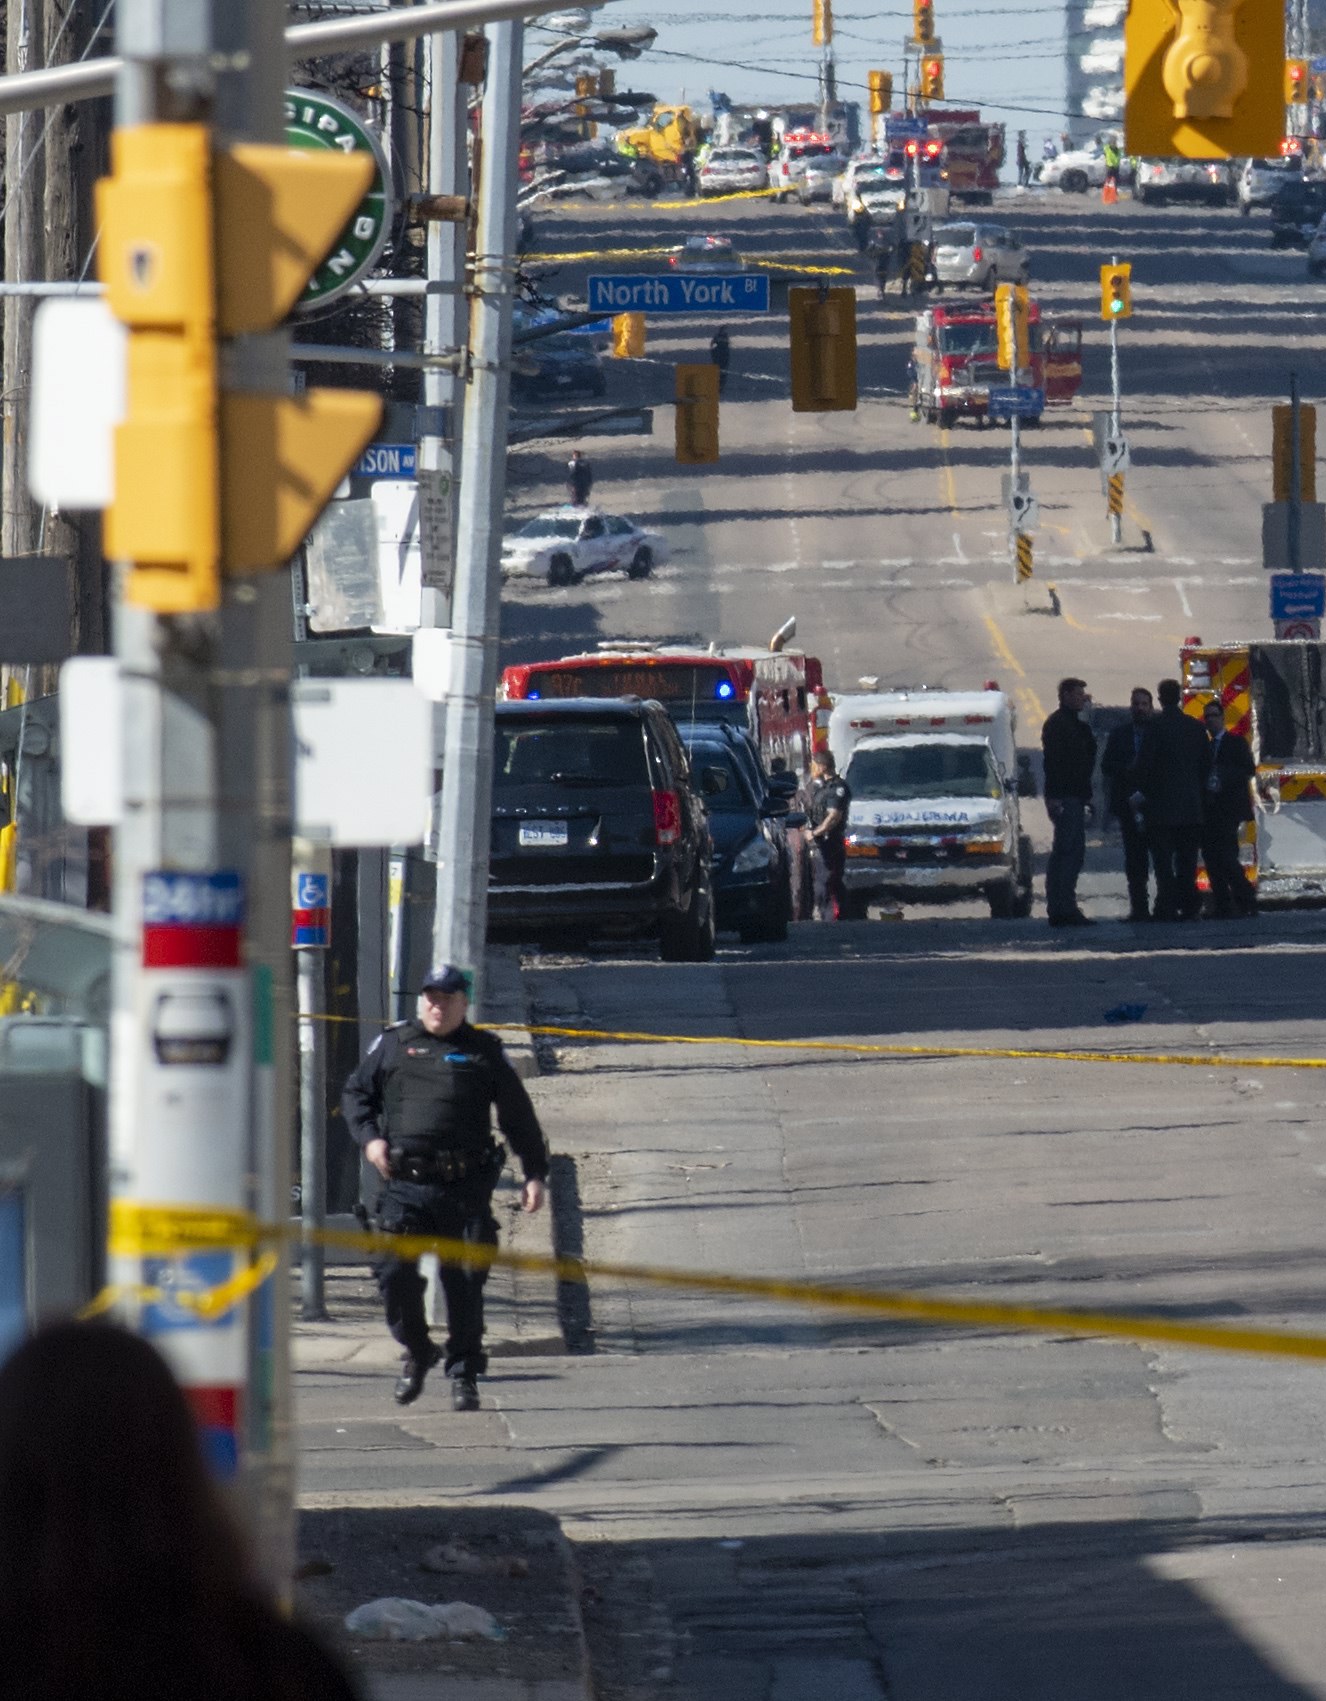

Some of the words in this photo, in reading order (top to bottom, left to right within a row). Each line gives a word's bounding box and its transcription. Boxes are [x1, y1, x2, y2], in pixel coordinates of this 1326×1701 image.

[597, 279, 669, 305] North
[680, 279, 736, 304] York
[745, 278, 757, 293] Bl
[402, 456, 414, 467] AV
